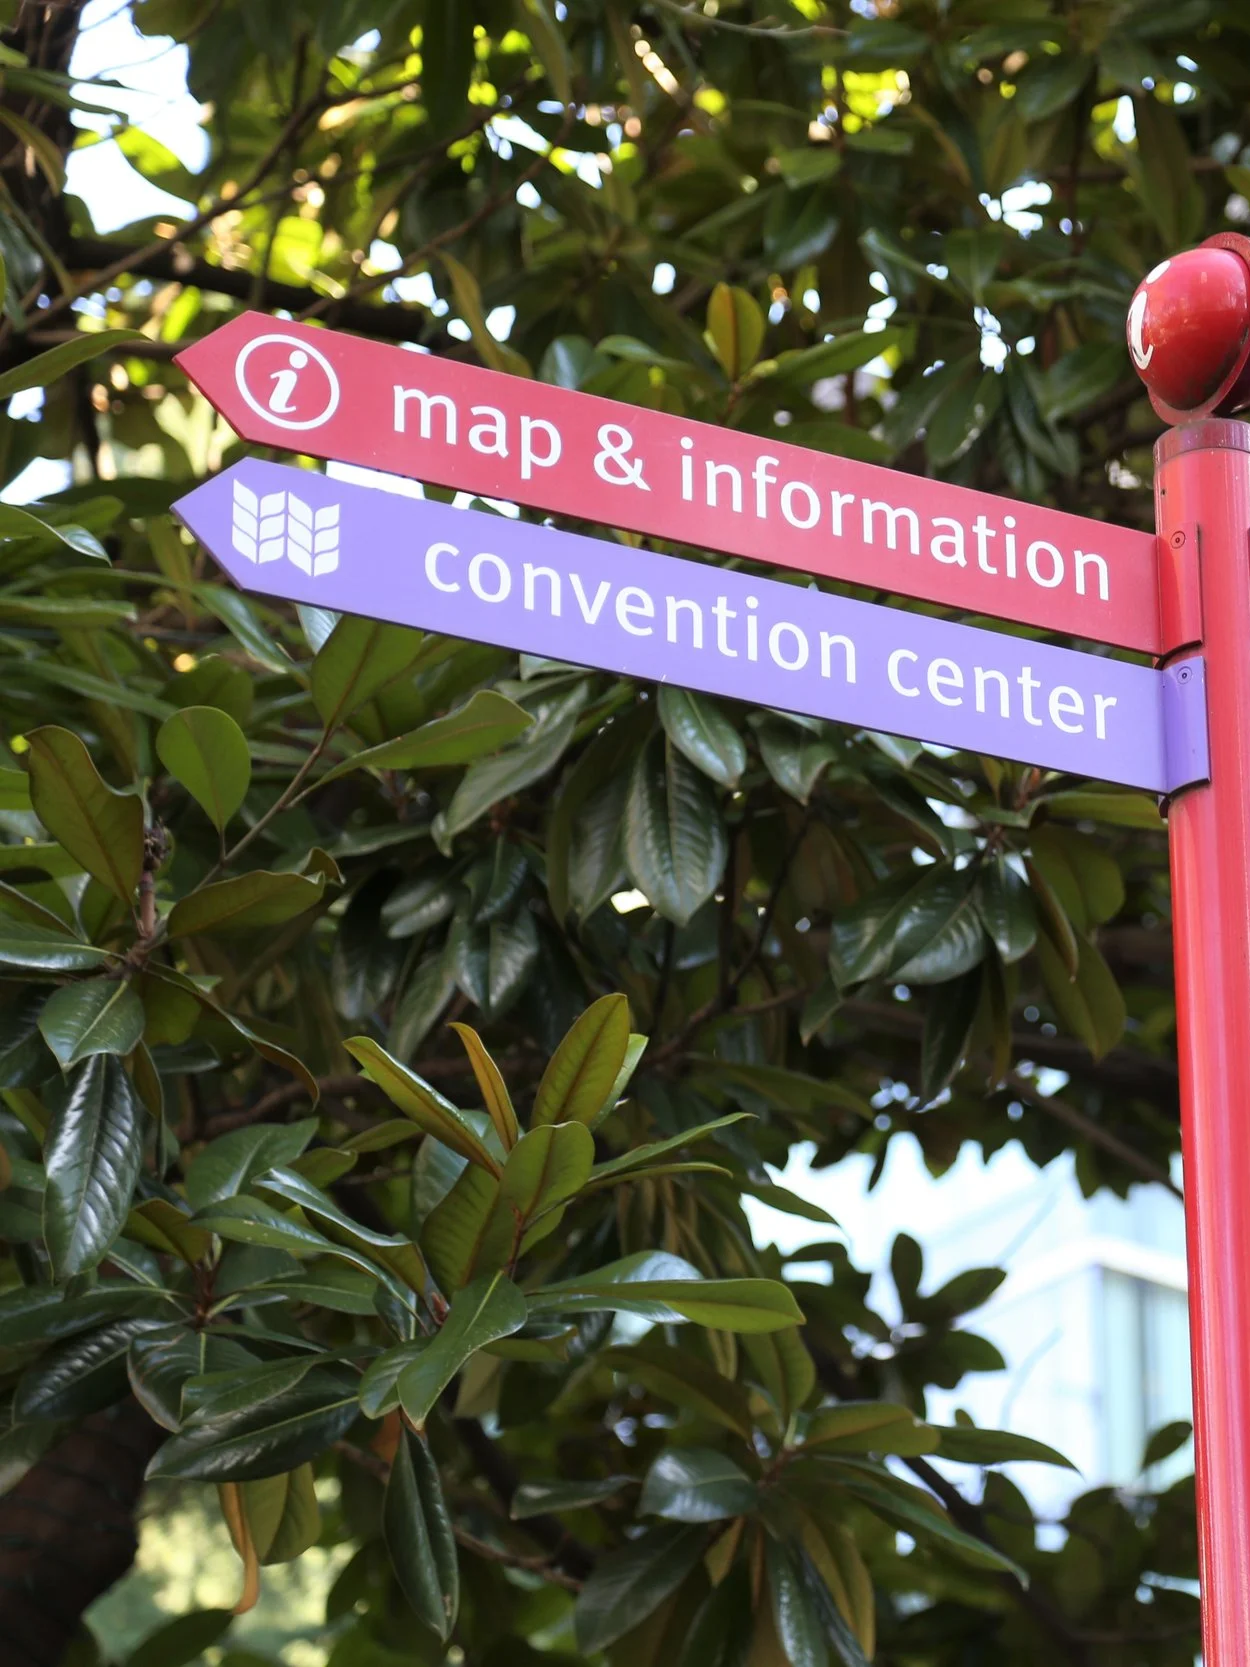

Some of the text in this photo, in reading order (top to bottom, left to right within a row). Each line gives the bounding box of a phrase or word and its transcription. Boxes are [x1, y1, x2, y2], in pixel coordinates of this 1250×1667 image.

[394, 385, 1109, 600] map & information
[424, 541, 1119, 741] convention center
